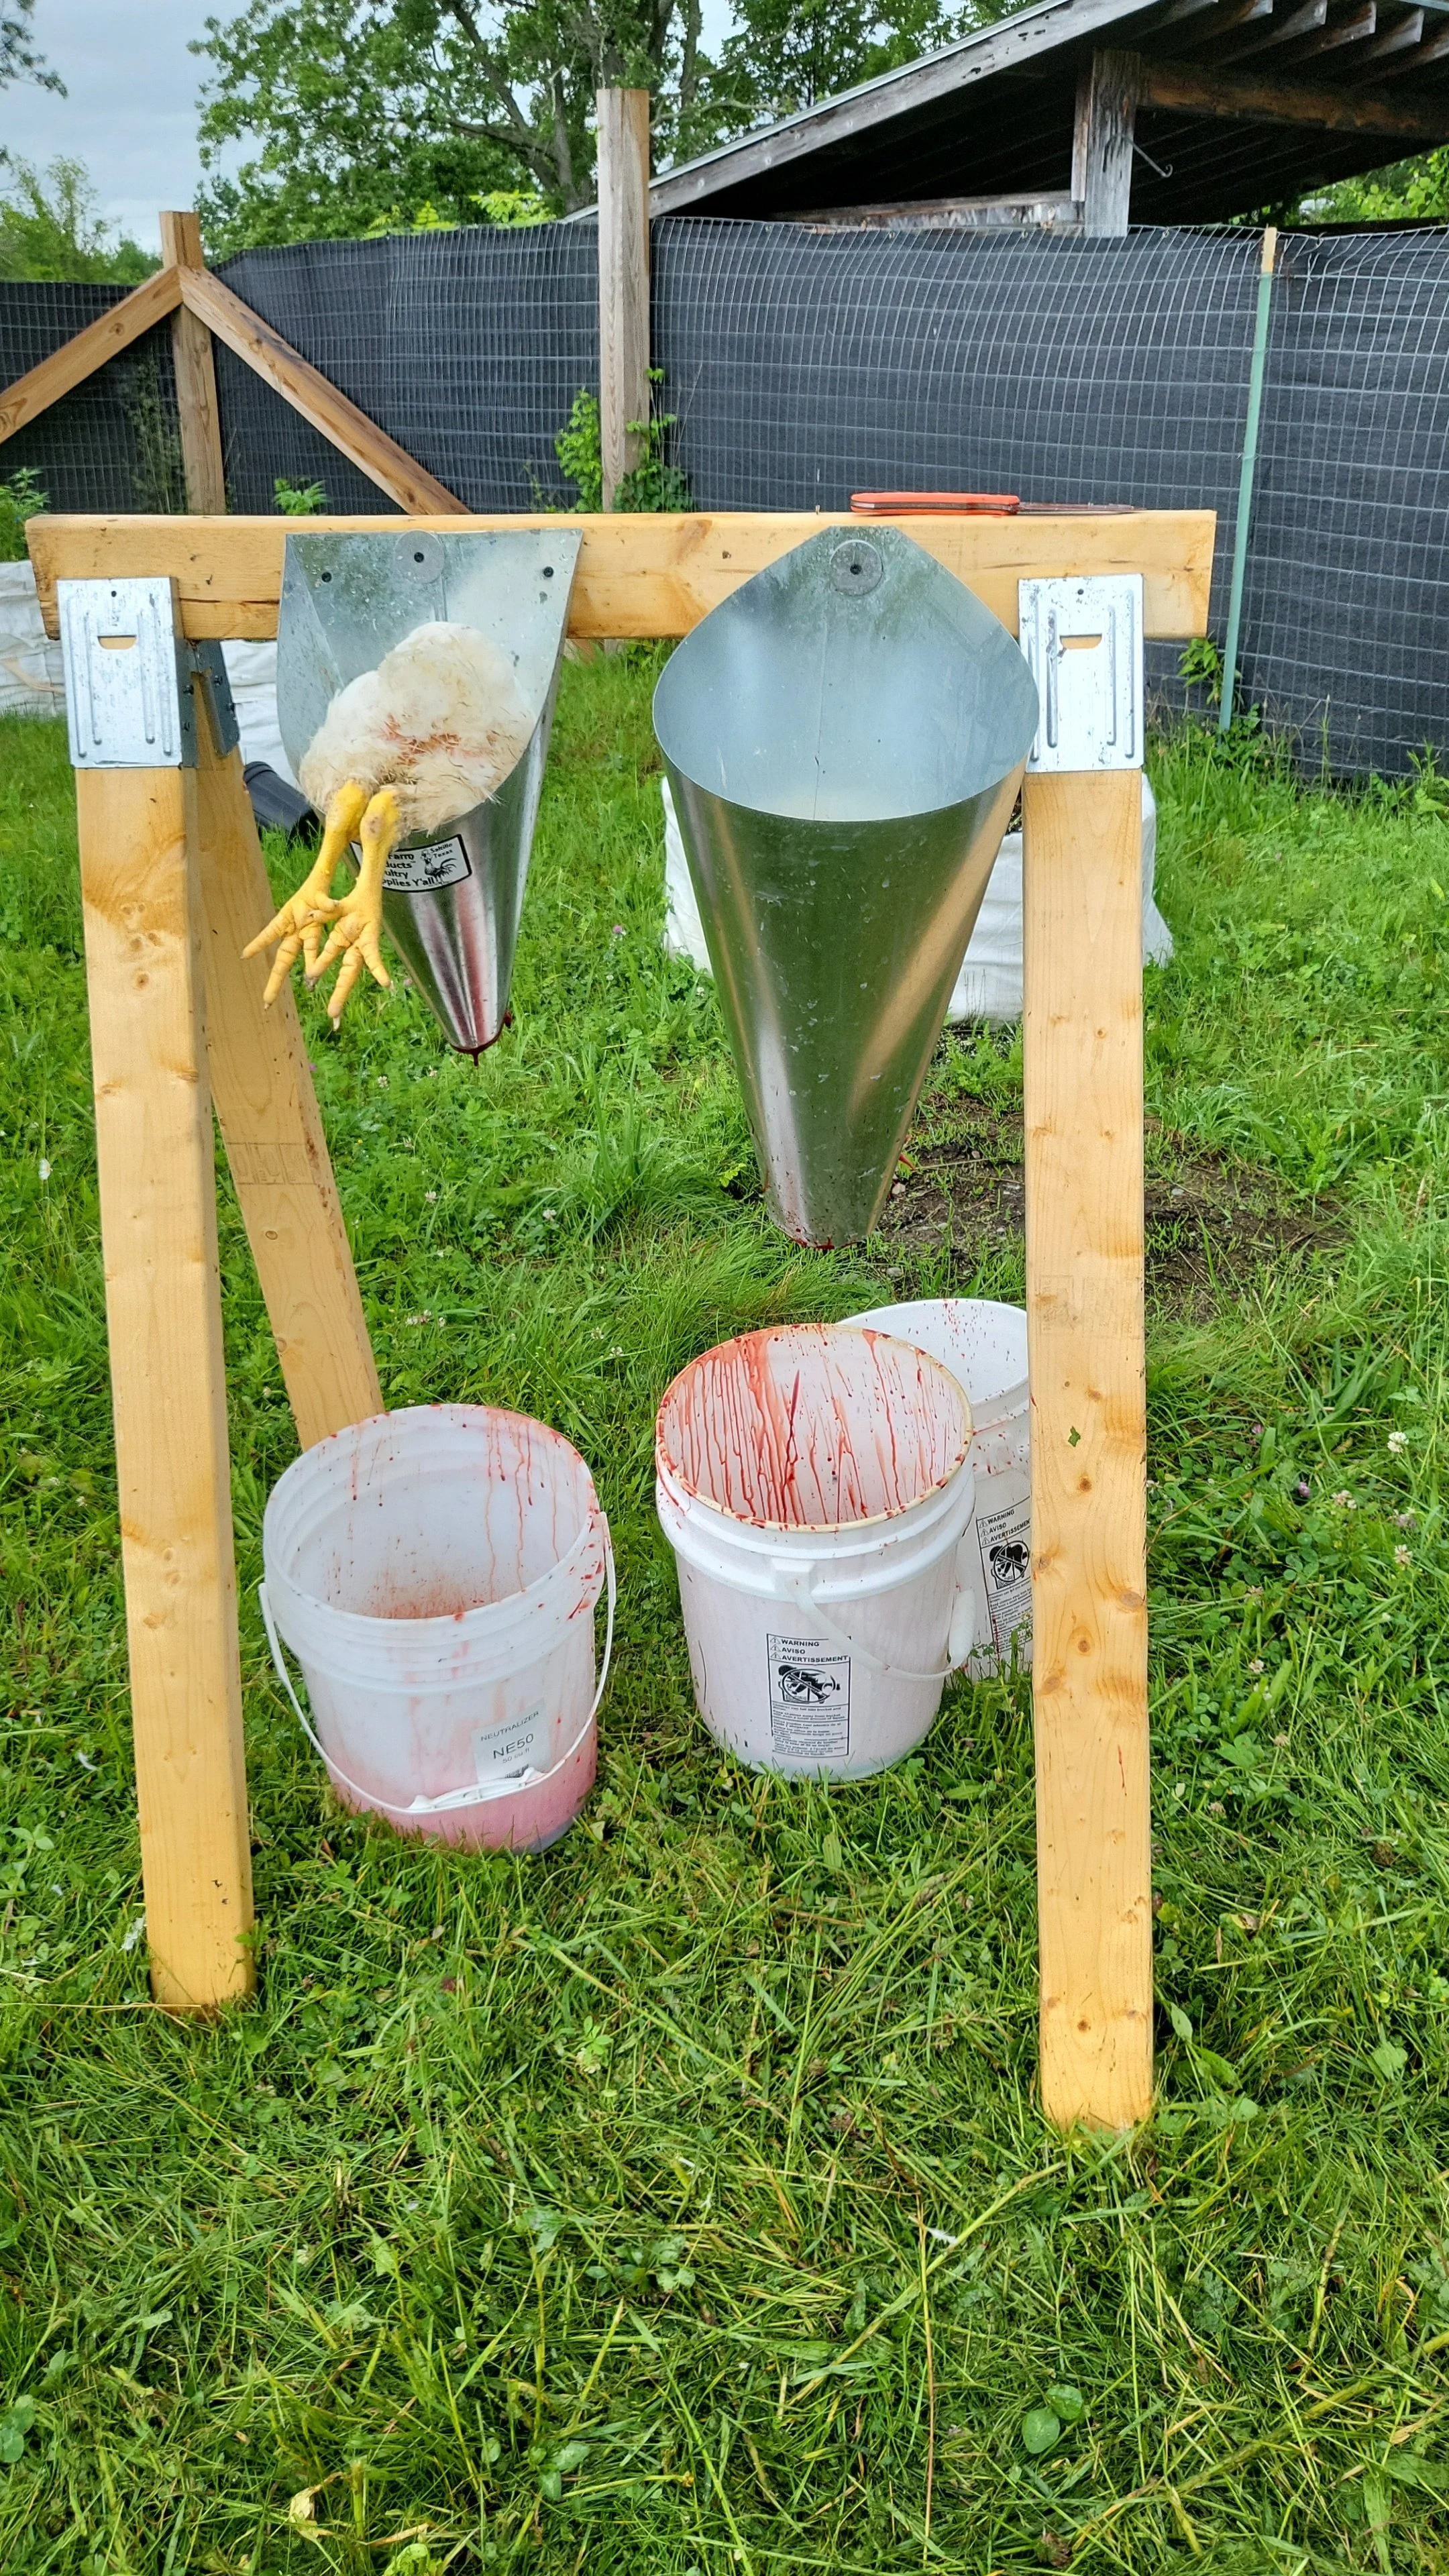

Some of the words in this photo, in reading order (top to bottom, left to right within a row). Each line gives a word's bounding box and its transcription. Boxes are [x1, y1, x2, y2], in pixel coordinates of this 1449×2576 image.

[433, 849, 453, 859] Texas
[384, 869, 408, 879] ultry
[987, 1509, 1015, 1525] WARNING
[989, 1522, 1007, 1534] AVISO
[990, 1517, 1030, 1542] AVERTISSEMEN
[781, 1639, 820, 1647] WARNING
[480, 1711, 539, 1741] NEUTRALIZER
[493, 1733, 534, 1759] NE50
